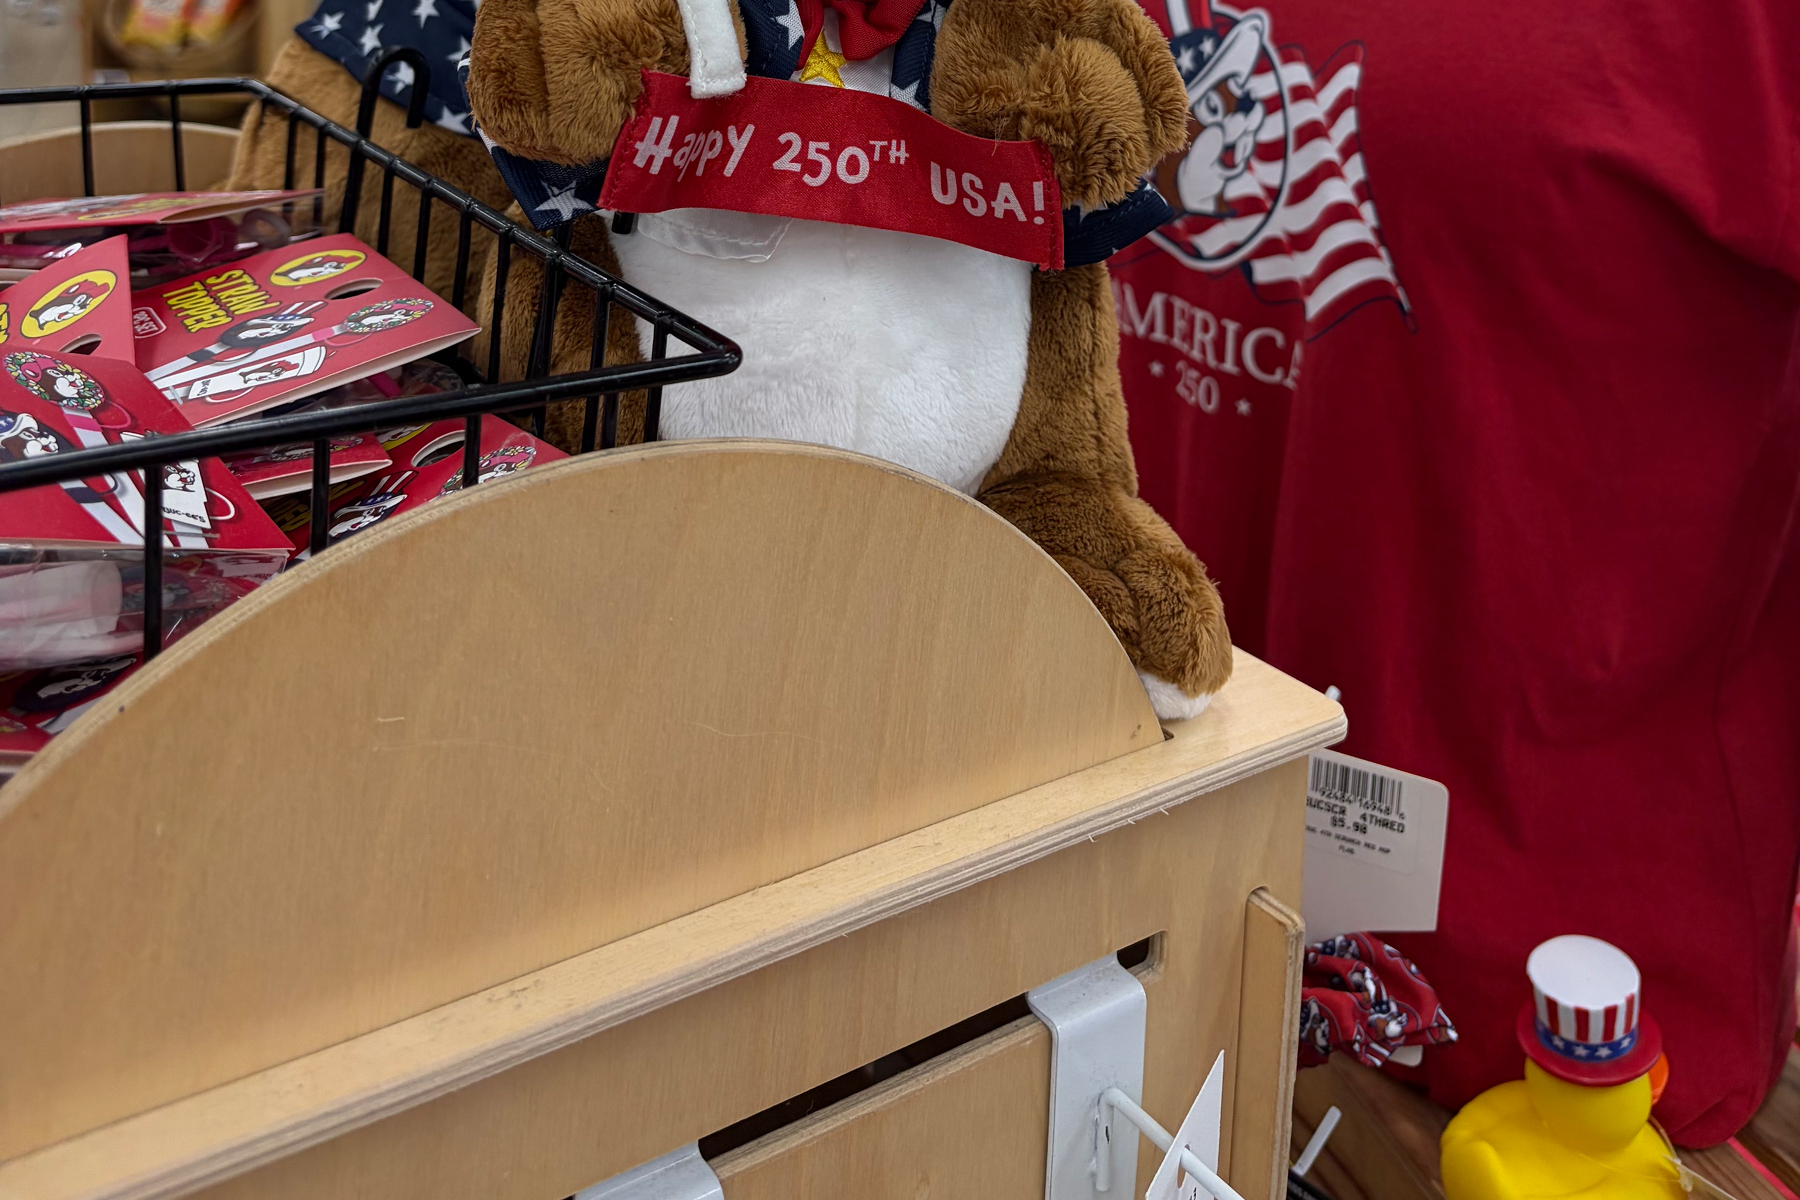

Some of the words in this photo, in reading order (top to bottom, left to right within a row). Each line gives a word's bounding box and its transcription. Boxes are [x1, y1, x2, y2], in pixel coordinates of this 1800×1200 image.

[930, 161, 1044, 225] USA!
[161, 280, 233, 333] TOPPER
[204, 269, 281, 315] STRAW
[1175, 359, 1221, 414] 250
[1306, 795, 1347, 816] UCSCR
[1330, 815, 1368, 835] $5.98
